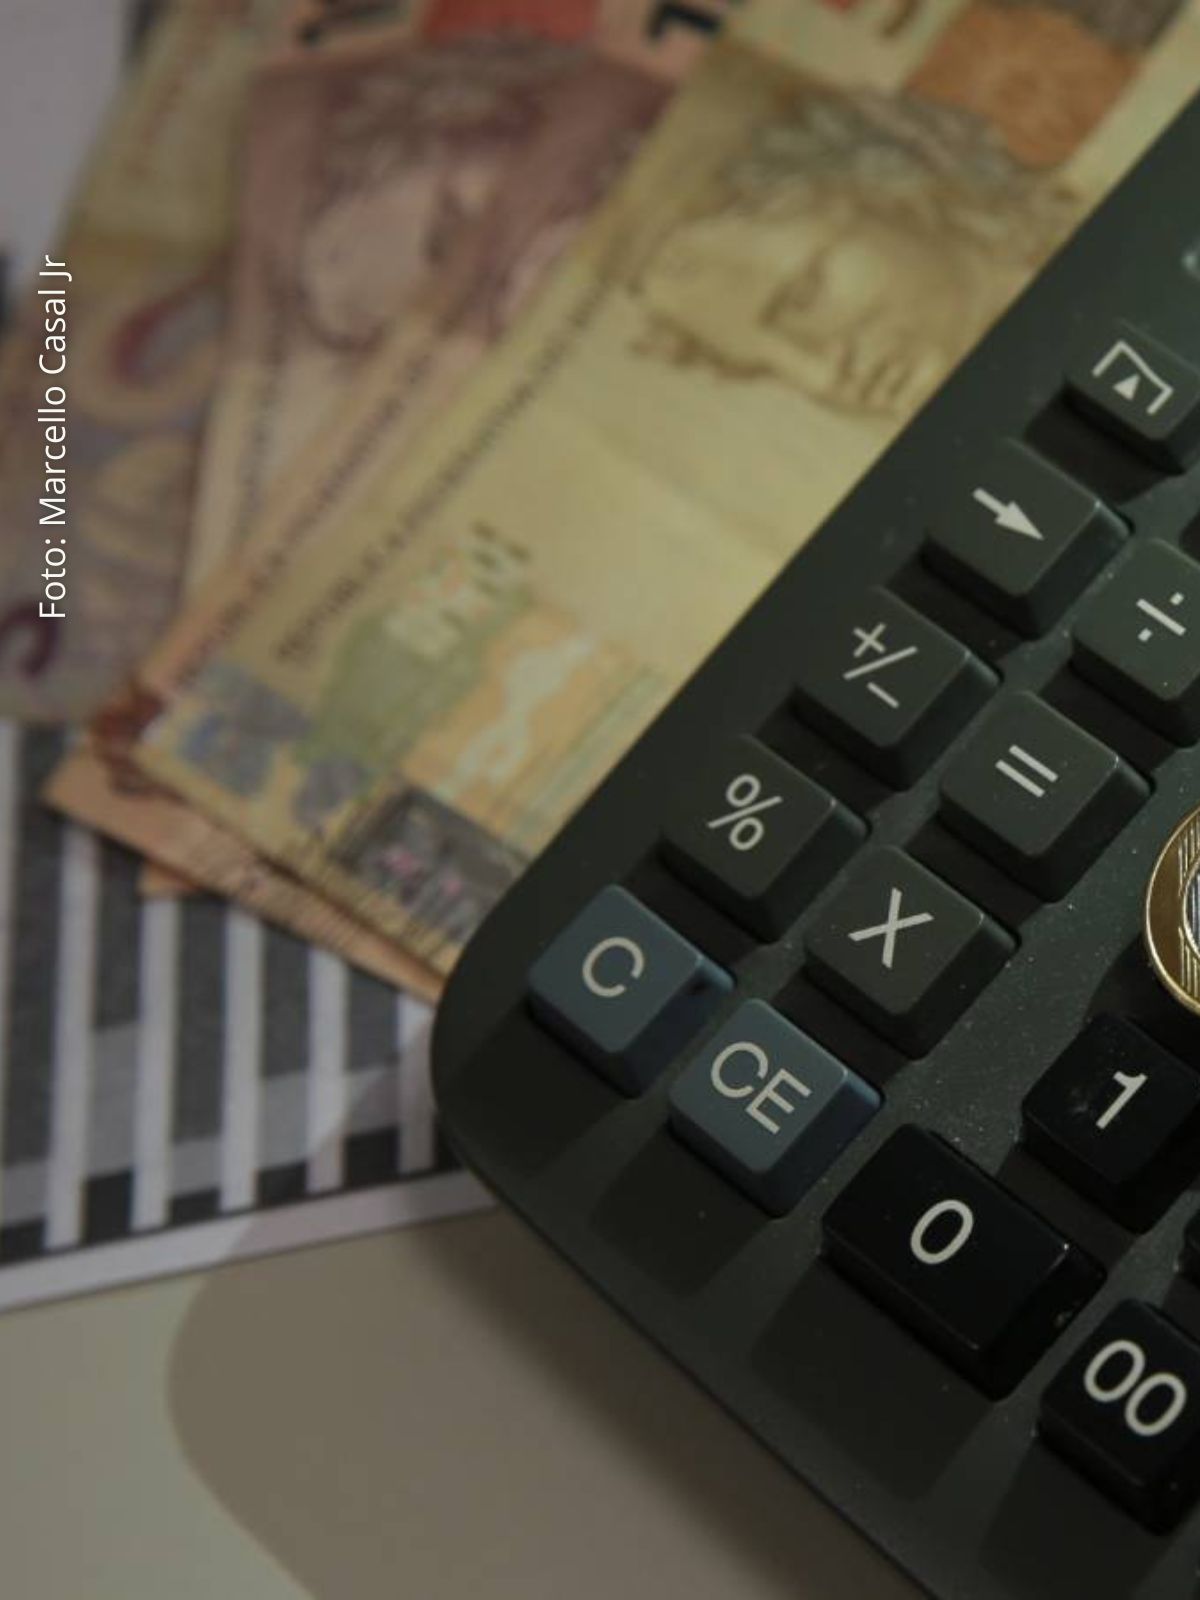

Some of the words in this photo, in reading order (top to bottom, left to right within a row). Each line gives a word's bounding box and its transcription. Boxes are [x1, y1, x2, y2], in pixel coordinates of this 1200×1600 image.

[583, 937, 644, 997] C
[711, 1042, 811, 1133] CE
[1097, 1072, 1146, 1128] 1
[911, 1200, 973, 1264] 0
[1085, 1340, 1186, 1435] 00
